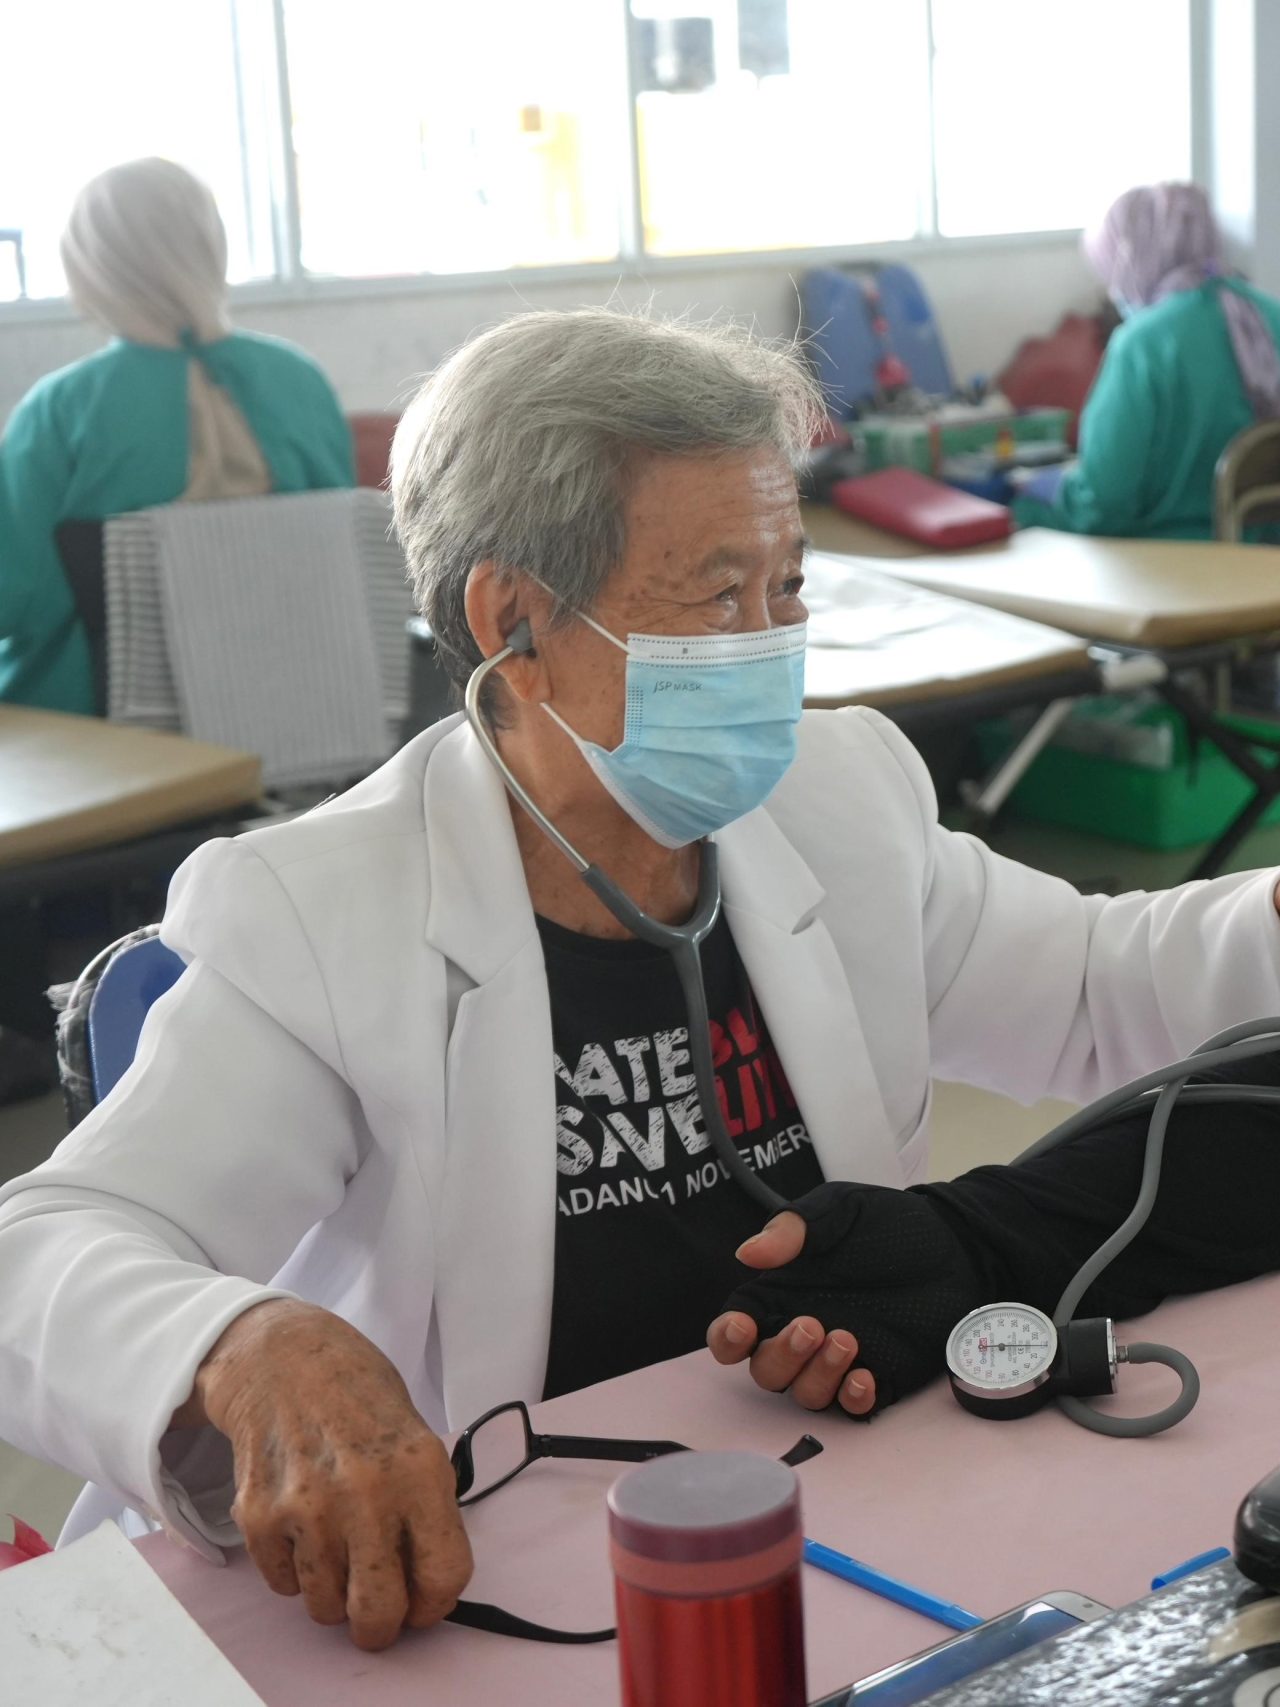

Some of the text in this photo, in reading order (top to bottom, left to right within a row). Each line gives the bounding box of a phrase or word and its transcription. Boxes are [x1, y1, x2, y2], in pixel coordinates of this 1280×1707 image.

[674, 682, 703, 692] MASK
[707, 1007, 759, 1068] BL
[556, 1092, 712, 1176] SAVE
[660, 1180, 676, 1206] 1
